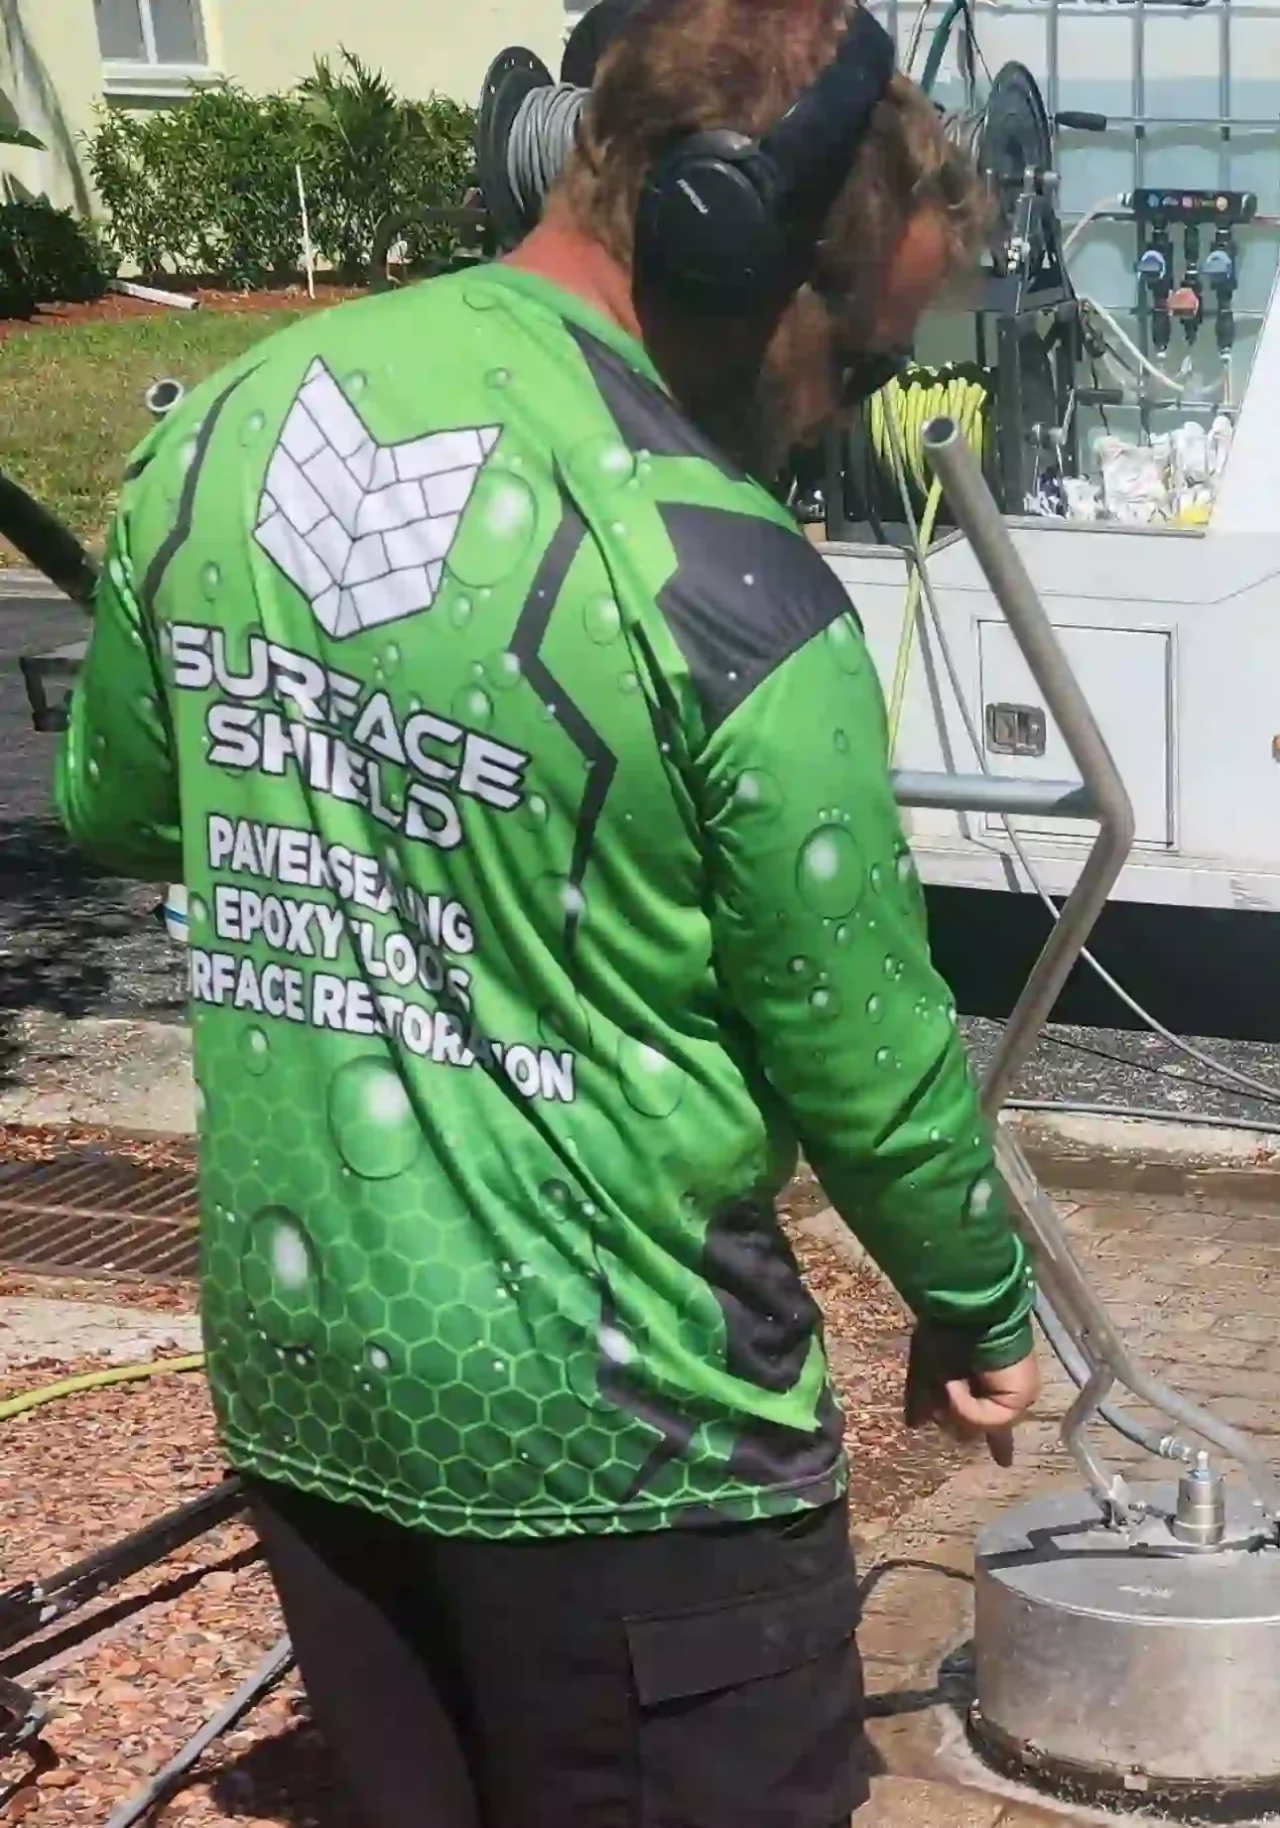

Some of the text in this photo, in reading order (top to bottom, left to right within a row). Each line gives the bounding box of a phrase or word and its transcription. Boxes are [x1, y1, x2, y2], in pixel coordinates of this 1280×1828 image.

[171, 624, 529, 810] SURFACE
[207, 703, 463, 849] SHIELD
[214, 885, 471, 1013] EPOXY LOOS
[327, 845, 475, 954] SEING
[191, 949, 306, 1022] RFACE
